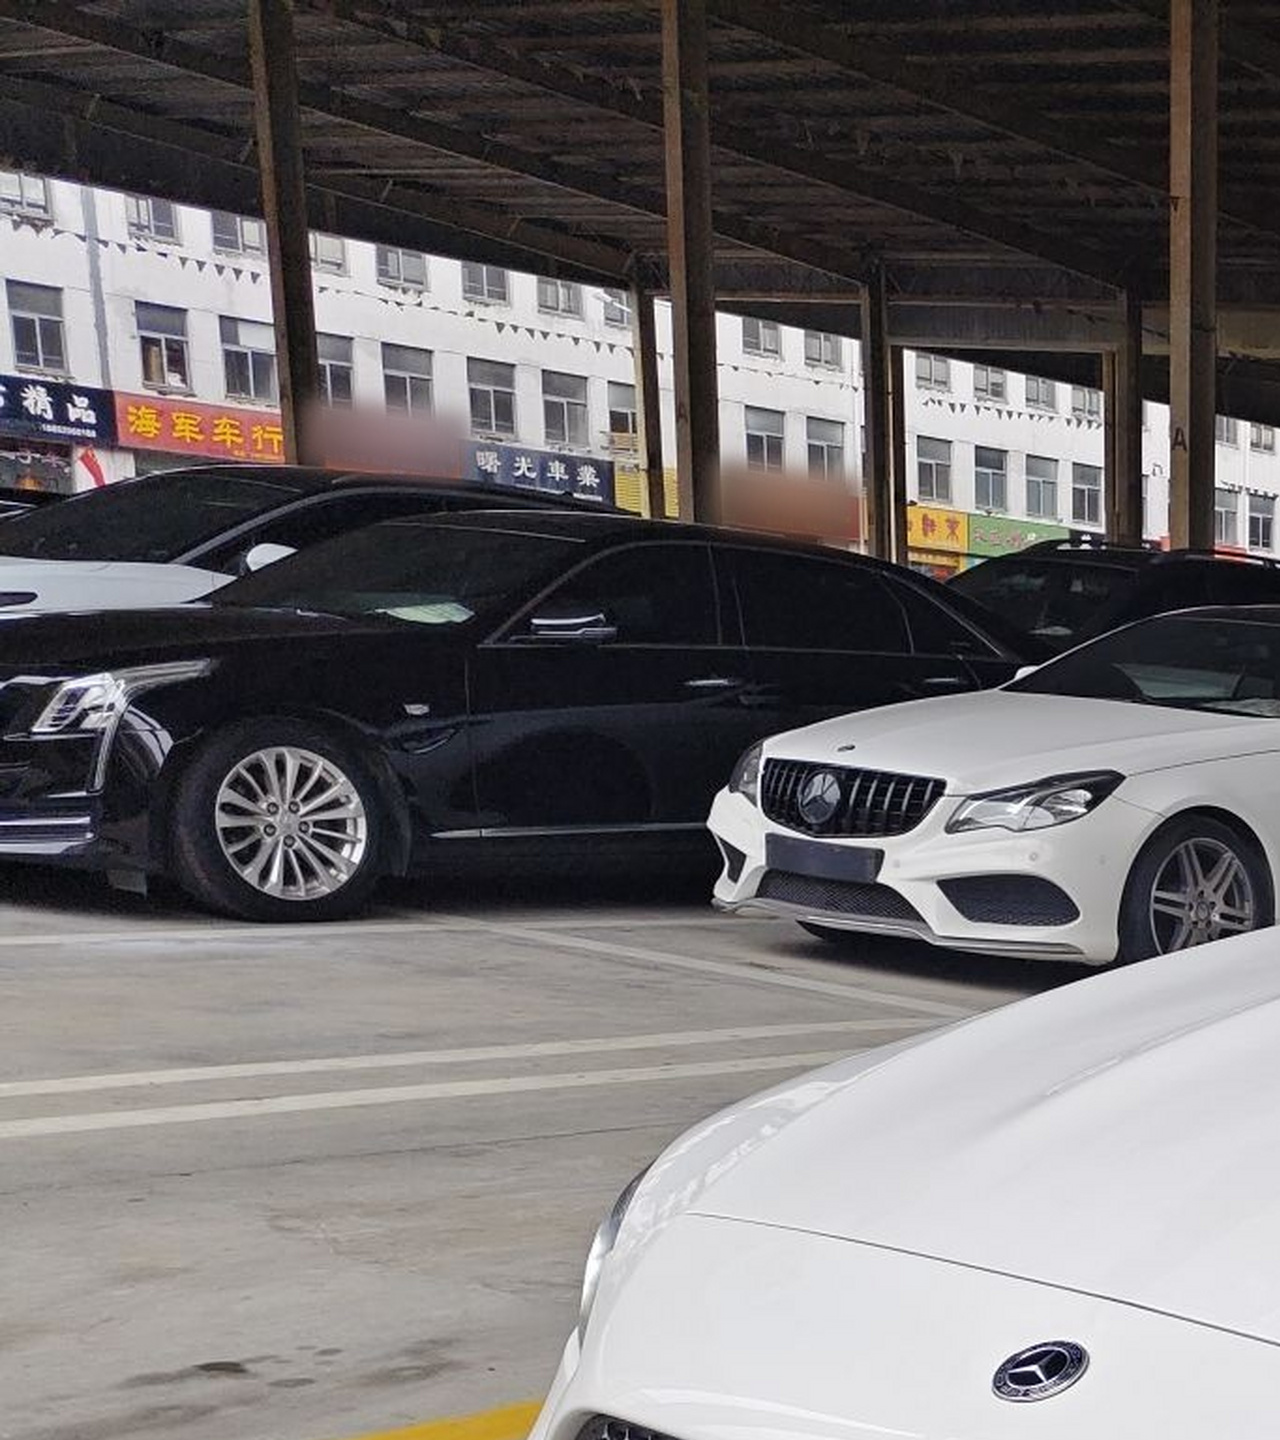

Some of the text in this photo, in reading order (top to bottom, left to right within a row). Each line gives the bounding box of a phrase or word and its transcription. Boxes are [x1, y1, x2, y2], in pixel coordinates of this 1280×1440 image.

[127, 405, 283, 453] 海军车行
[1172, 427, 1187, 452] A
